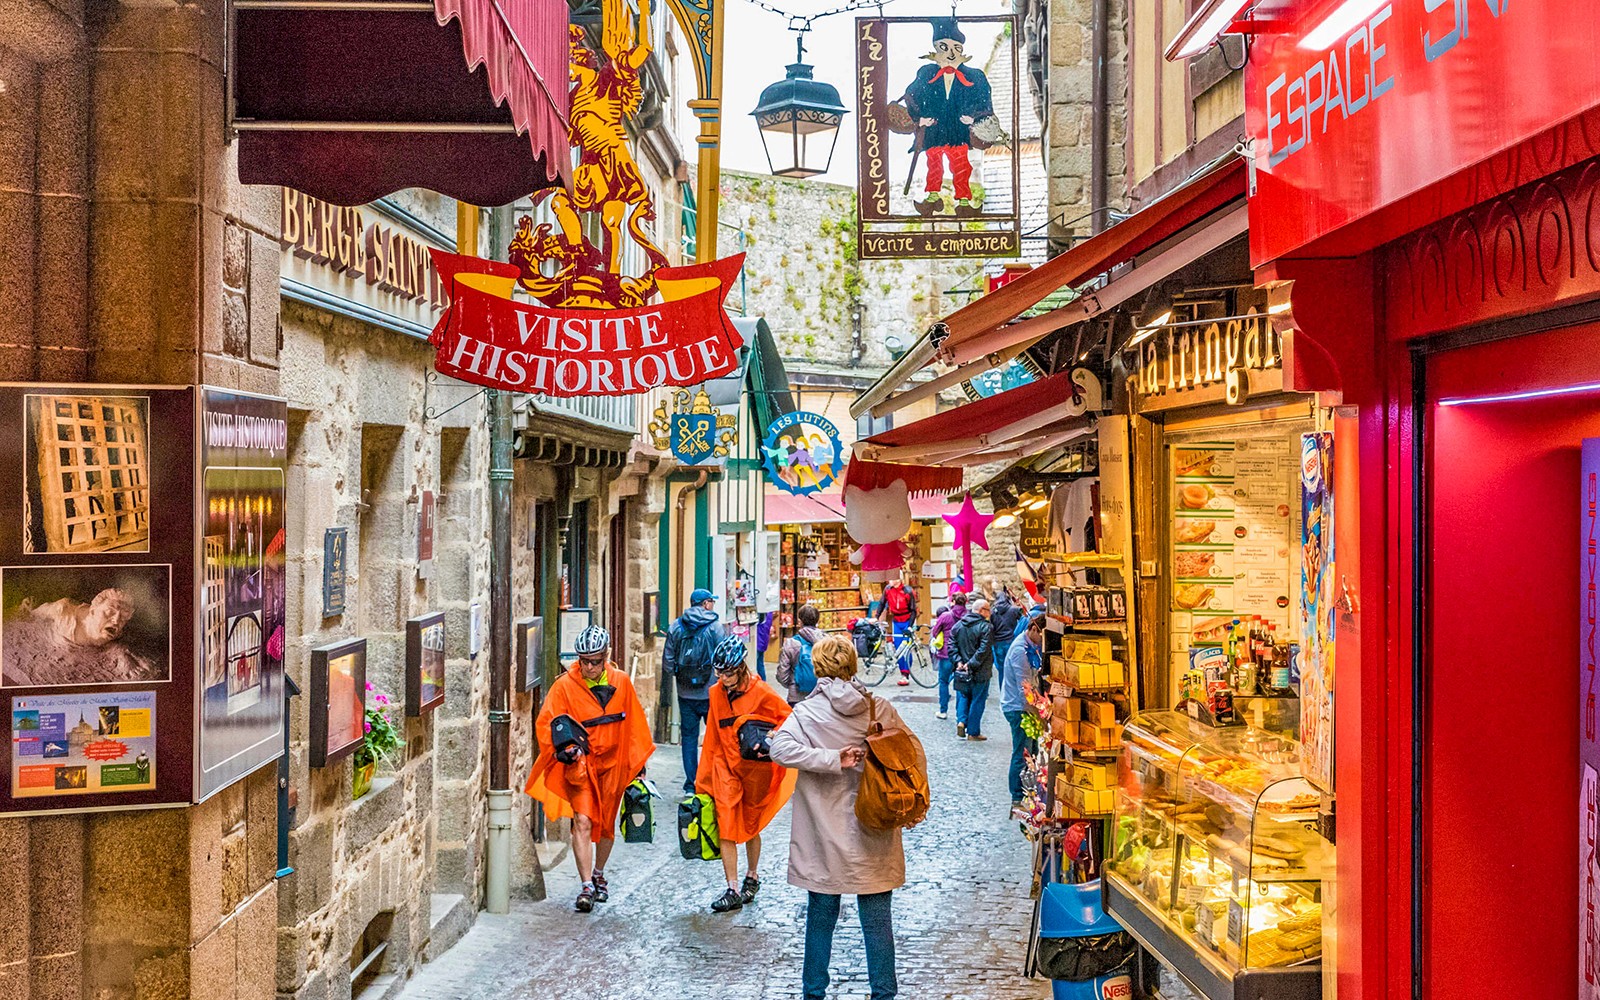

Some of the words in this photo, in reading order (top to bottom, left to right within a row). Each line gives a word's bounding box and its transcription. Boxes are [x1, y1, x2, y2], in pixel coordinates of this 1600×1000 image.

[1266, 4, 1394, 169] ESPACE
[514, 309, 668, 353] VISITE
[447, 333, 729, 393] HISTORIQUE
[203, 410, 233, 447] VISITE
[235, 414, 285, 458] HISTORIQUE
[771, 416, 792, 435] LES
[427, 504, 433, 529] H
[1586, 472, 1597, 743] SNACKING
[1585, 778, 1595, 986] ESPACE
